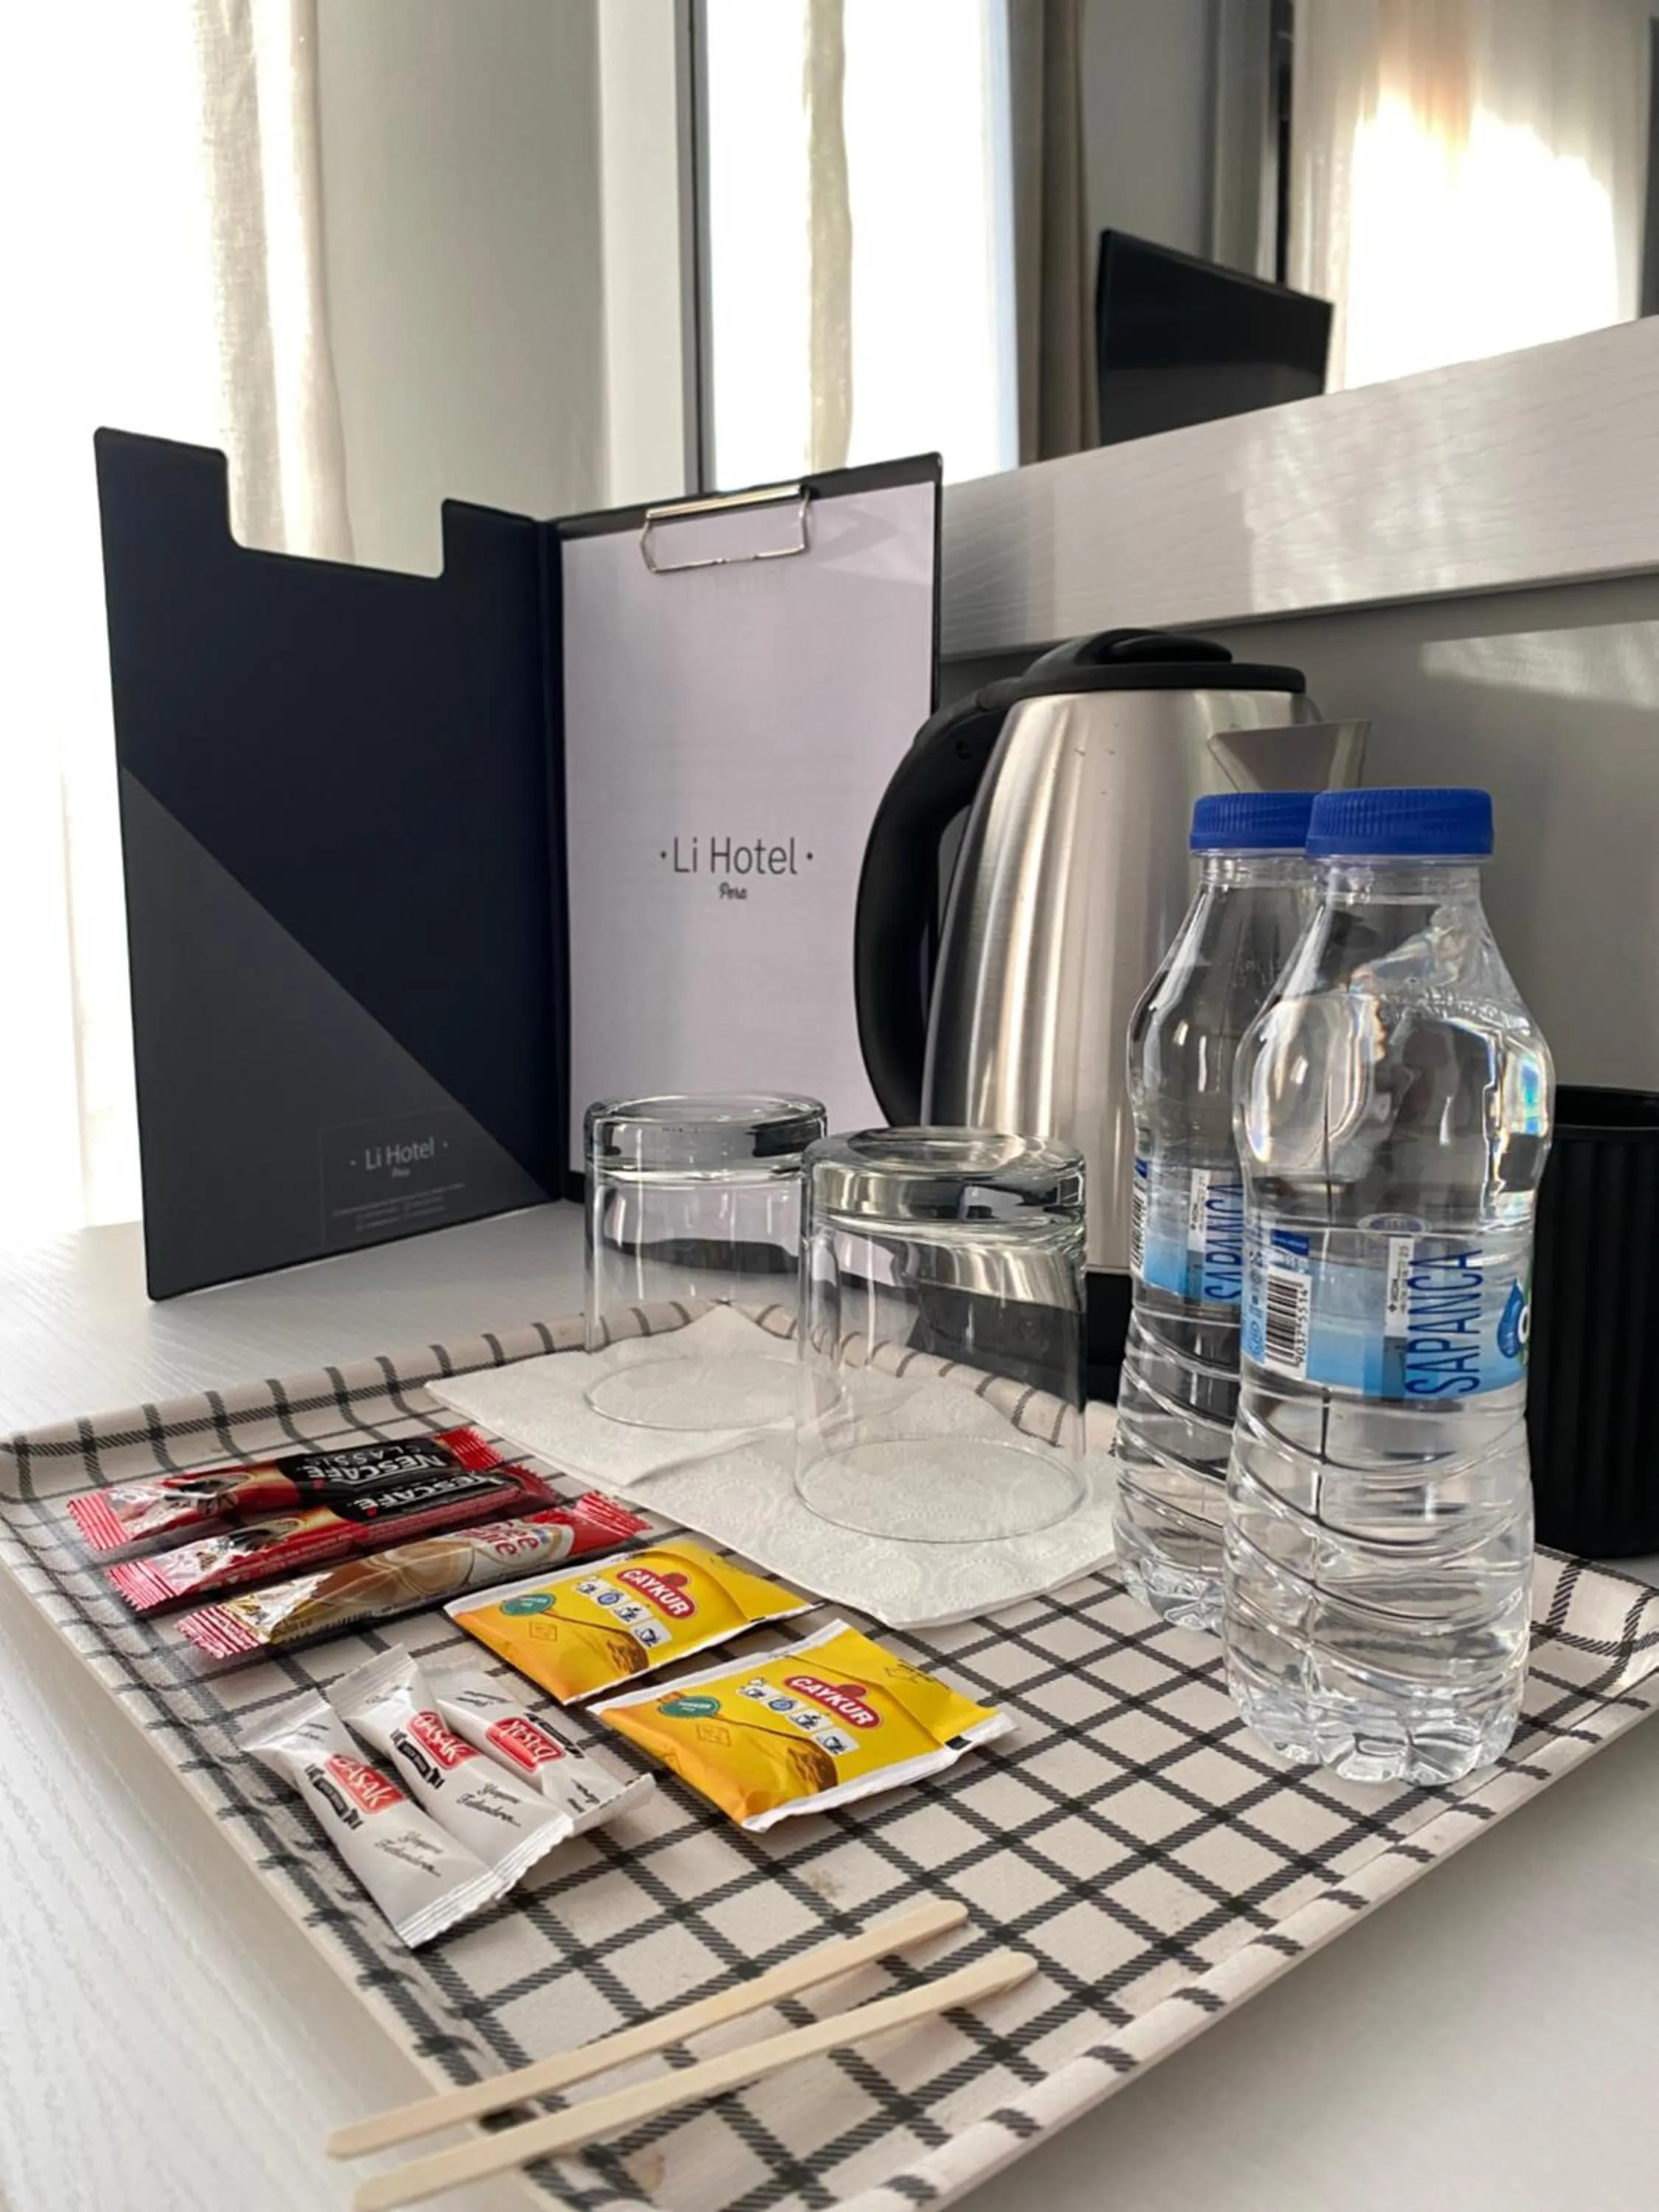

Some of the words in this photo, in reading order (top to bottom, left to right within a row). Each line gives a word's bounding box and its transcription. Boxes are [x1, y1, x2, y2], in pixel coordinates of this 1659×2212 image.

[673, 836, 698, 873] Li
[710, 836, 798, 875] Hotel
[365, 1147, 383, 1171] Li
[386, 1135, 435, 1166] Hotel
[1405, 1249, 1484, 1395] SAPANCA
